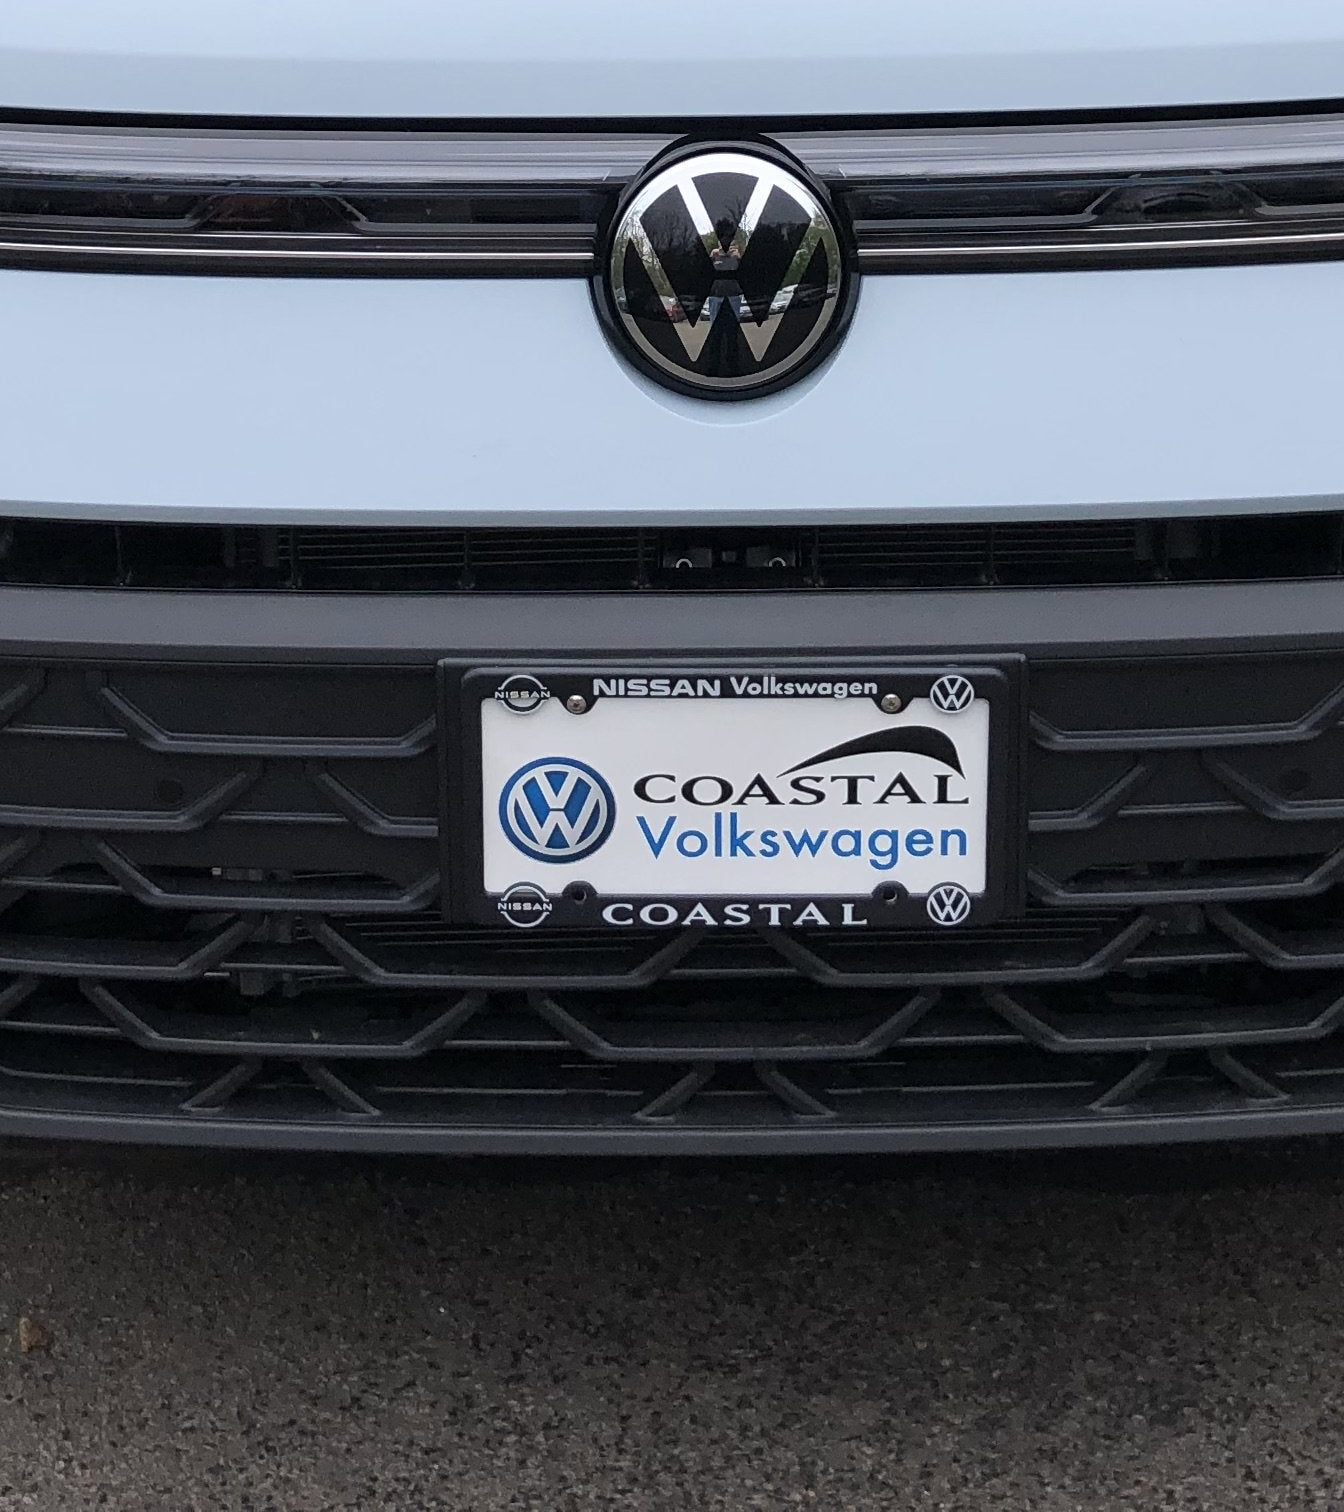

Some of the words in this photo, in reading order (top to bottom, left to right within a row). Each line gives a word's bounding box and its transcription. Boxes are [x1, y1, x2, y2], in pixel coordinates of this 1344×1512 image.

[619, 158, 834, 374] VW
[494, 689, 551, 699] NISSAN
[593, 678, 721, 698] NISSAN
[730, 675, 878, 699] Volkswagen
[931, 676, 973, 712] VW
[632, 771, 971, 807] COASTAL
[506, 763, 609, 856] VW
[636, 811, 968, 871] Volkswagen
[497, 901, 553, 912] NISSAN
[601, 902, 868, 927] COASTAL
[928, 884, 969, 925] VW
